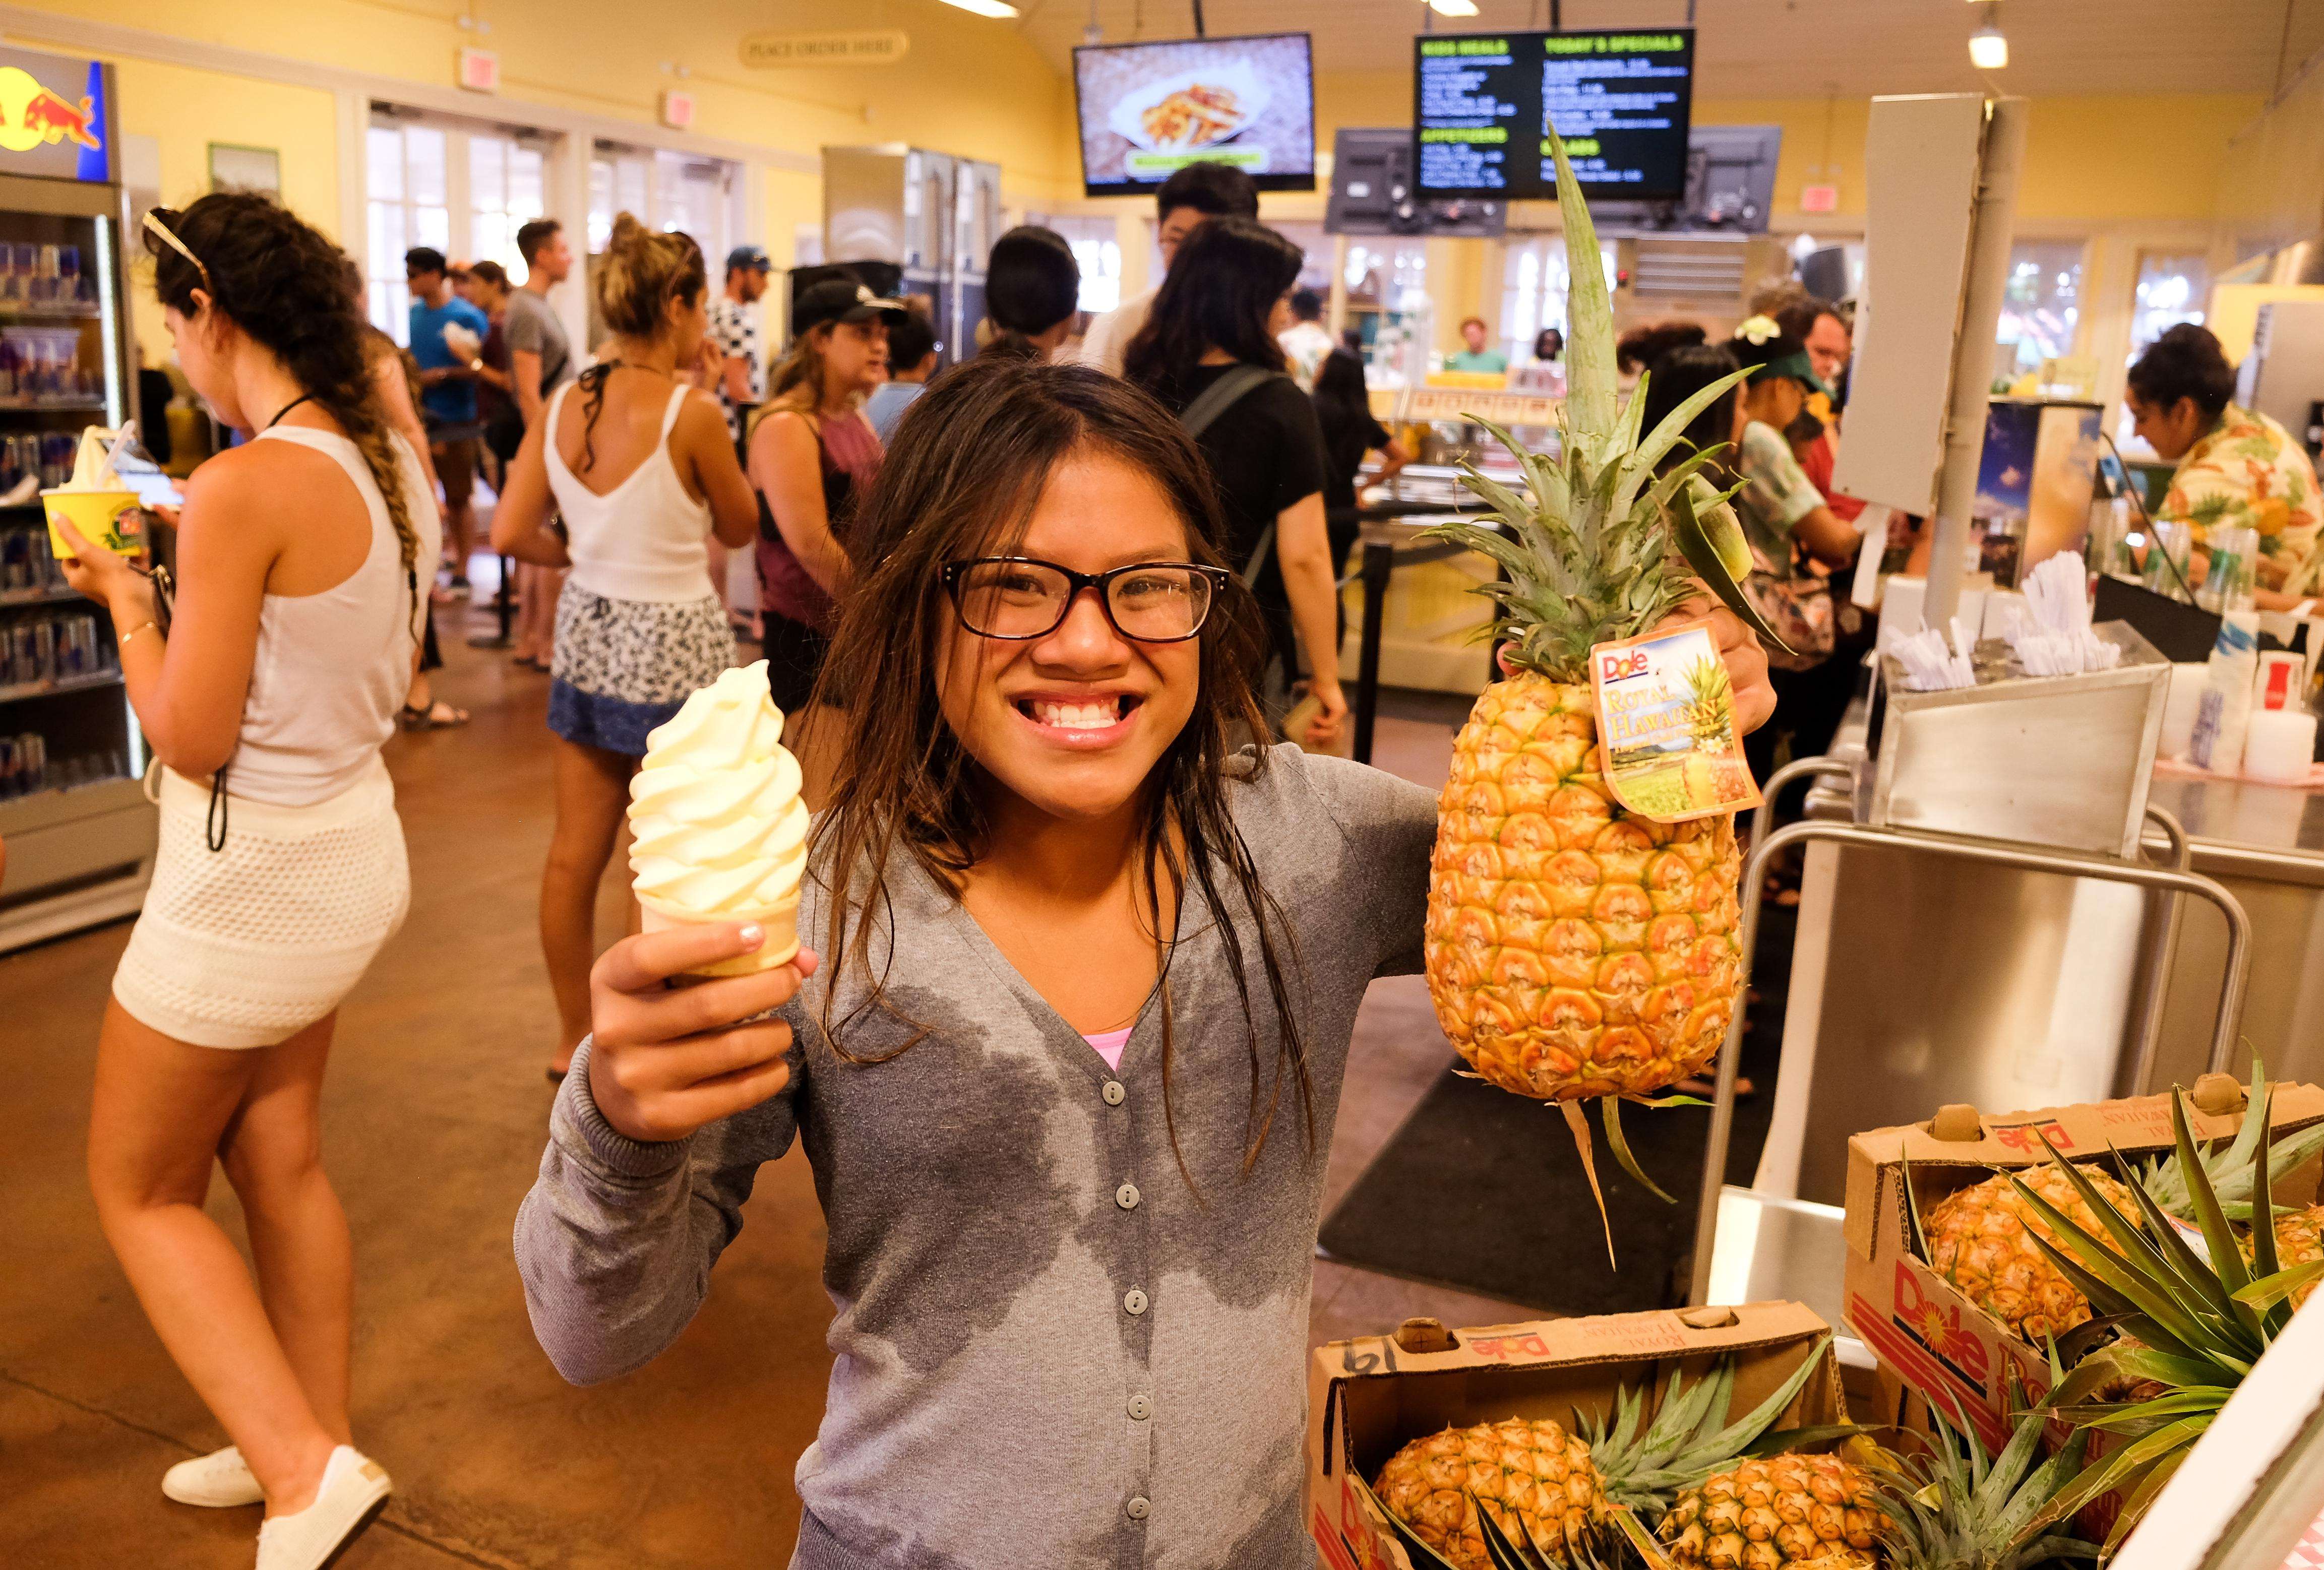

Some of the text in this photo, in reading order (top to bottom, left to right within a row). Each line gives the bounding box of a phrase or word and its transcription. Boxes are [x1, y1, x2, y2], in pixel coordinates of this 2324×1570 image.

[1608, 34, 1685, 52] SPECIALS
[1602, 650, 1648, 679] Dole
[1604, 684, 1675, 715] ROYAL
[1609, 698, 1720, 740] HAWAIIAN
[1996, 1124, 2075, 1154] Dole
[1893, 1259, 1989, 1381] Dole
[1471, 1335, 1551, 1360] Dole
